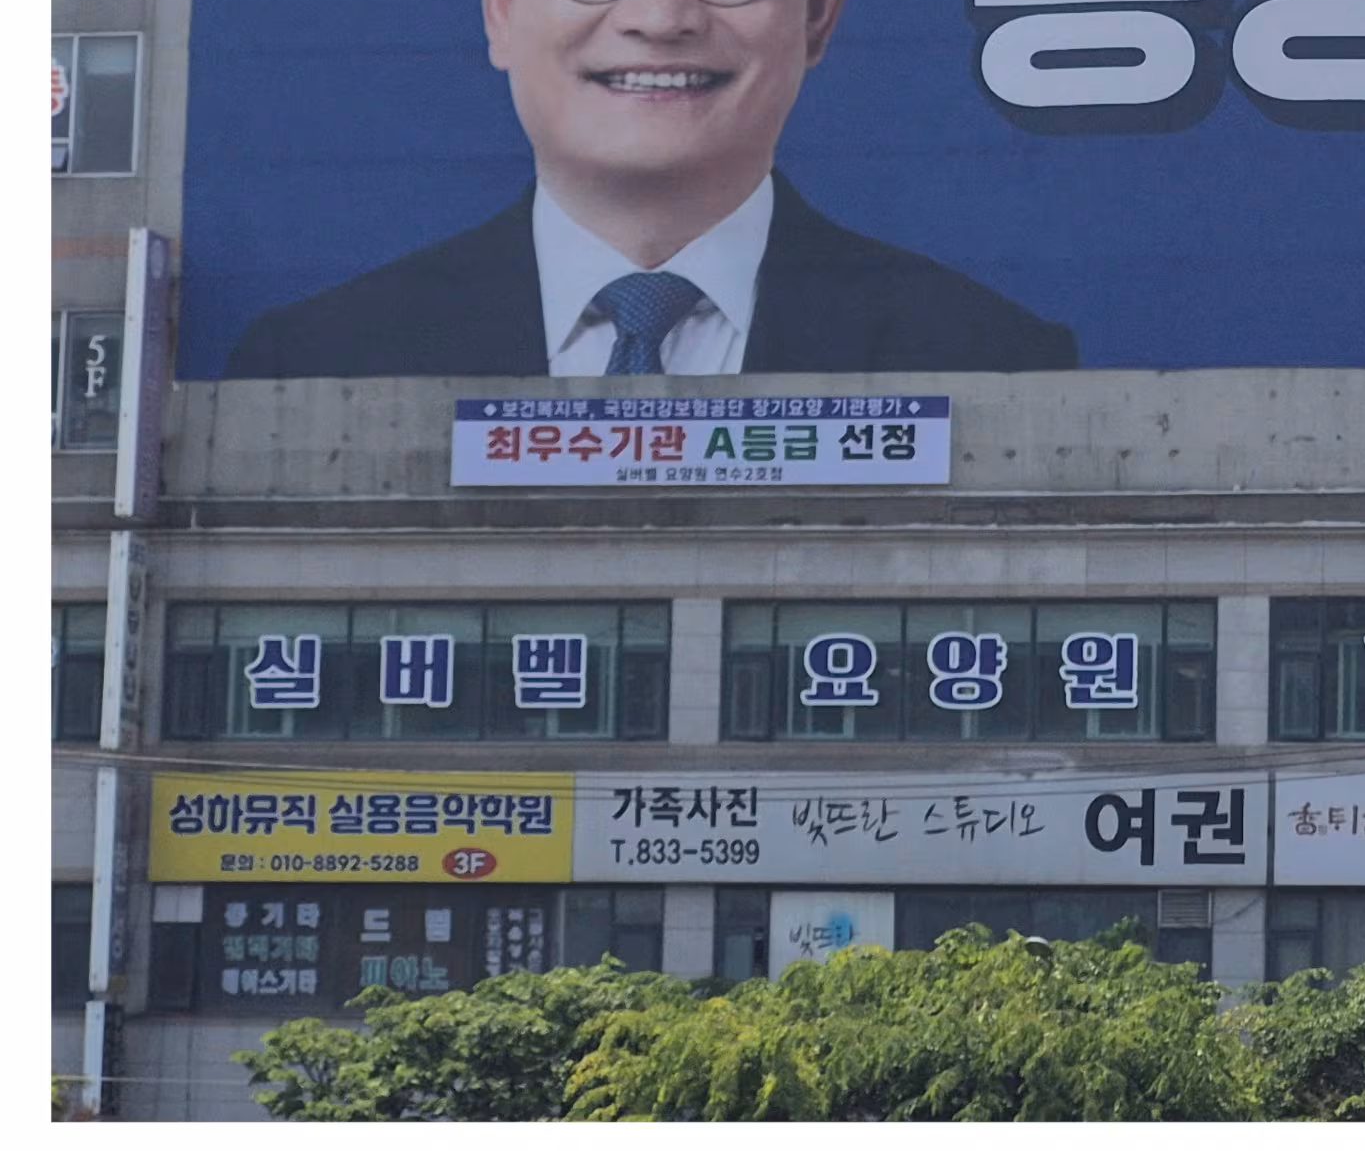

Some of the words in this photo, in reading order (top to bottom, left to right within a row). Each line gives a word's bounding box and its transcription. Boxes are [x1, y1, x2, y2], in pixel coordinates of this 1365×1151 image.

[501, 399, 596, 420] 보건복지부,
[604, 398, 746, 418] 국민건강보험공단
[751, 398, 823, 417] 장기요양
[831, 397, 902, 416] 기관평가
[486, 425, 687, 463] 최우수기관
[703, 423, 819, 462] A등급
[838, 422, 917, 461] 선정
[615, 466, 658, 482] 실버벨
[665, 466, 707, 482] 요양원
[168, 793, 316, 837] 성하뮤직
[328, 793, 553, 836] 실용음악학원
[611, 785, 759, 829] 가족사진
[792, 796, 899, 845] 빛뜨란
[922, 795, 1046, 842] 스튜디오
[1084, 787, 1247, 866] 여권
[219, 853, 254, 872] 문의
[269, 854, 420, 872] 010-8892-5288
[452, 851, 487, 875] 3F
[609, 839, 760, 867] T.833-5399
